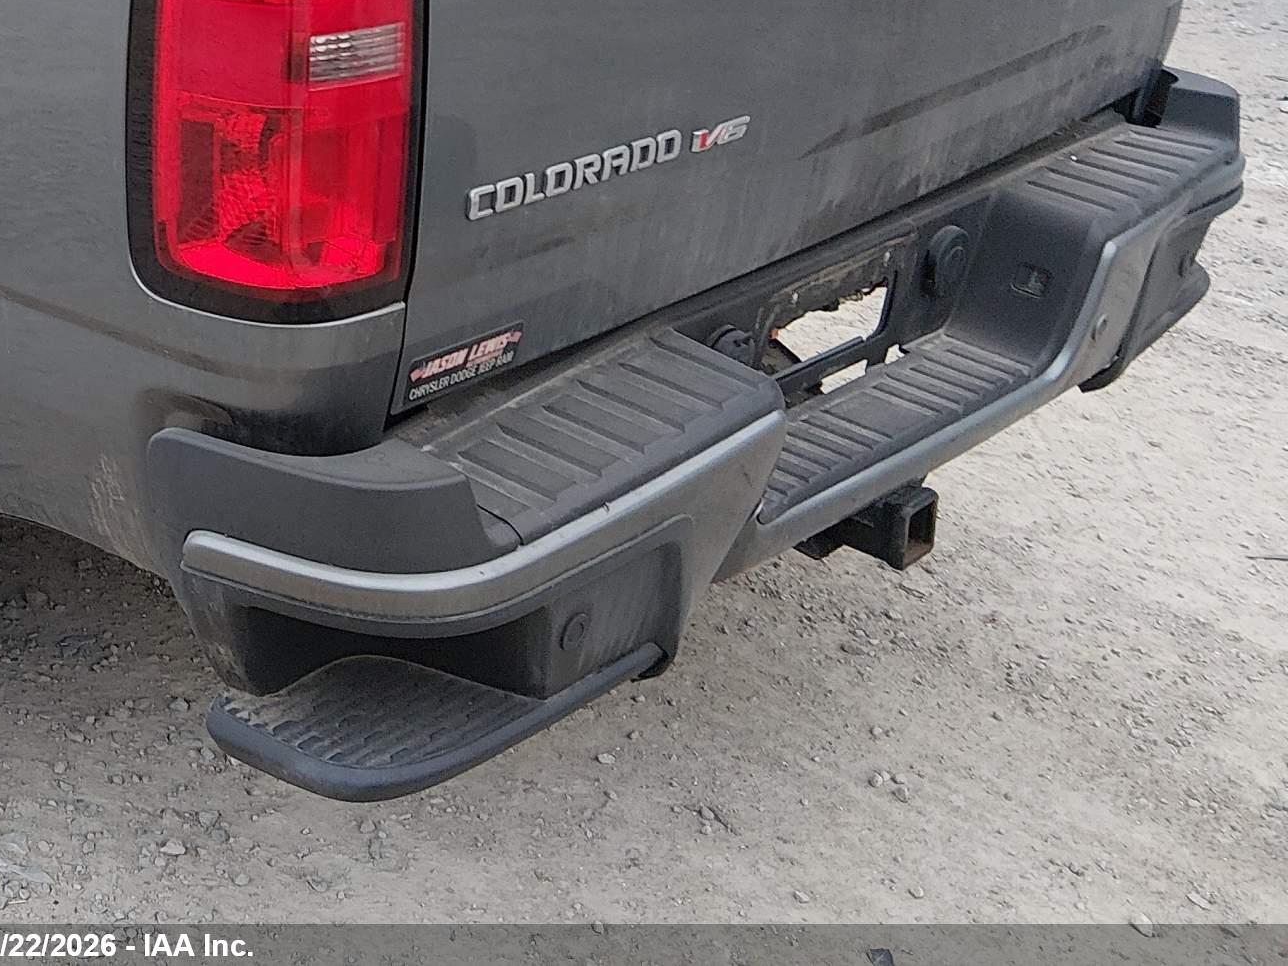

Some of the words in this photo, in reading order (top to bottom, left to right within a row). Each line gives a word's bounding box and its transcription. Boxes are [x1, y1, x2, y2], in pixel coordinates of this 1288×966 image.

[466, 129, 682, 221] COLORADO
[690, 115, 751, 153] V6
[409, 375, 450, 400] CHRYSLER
